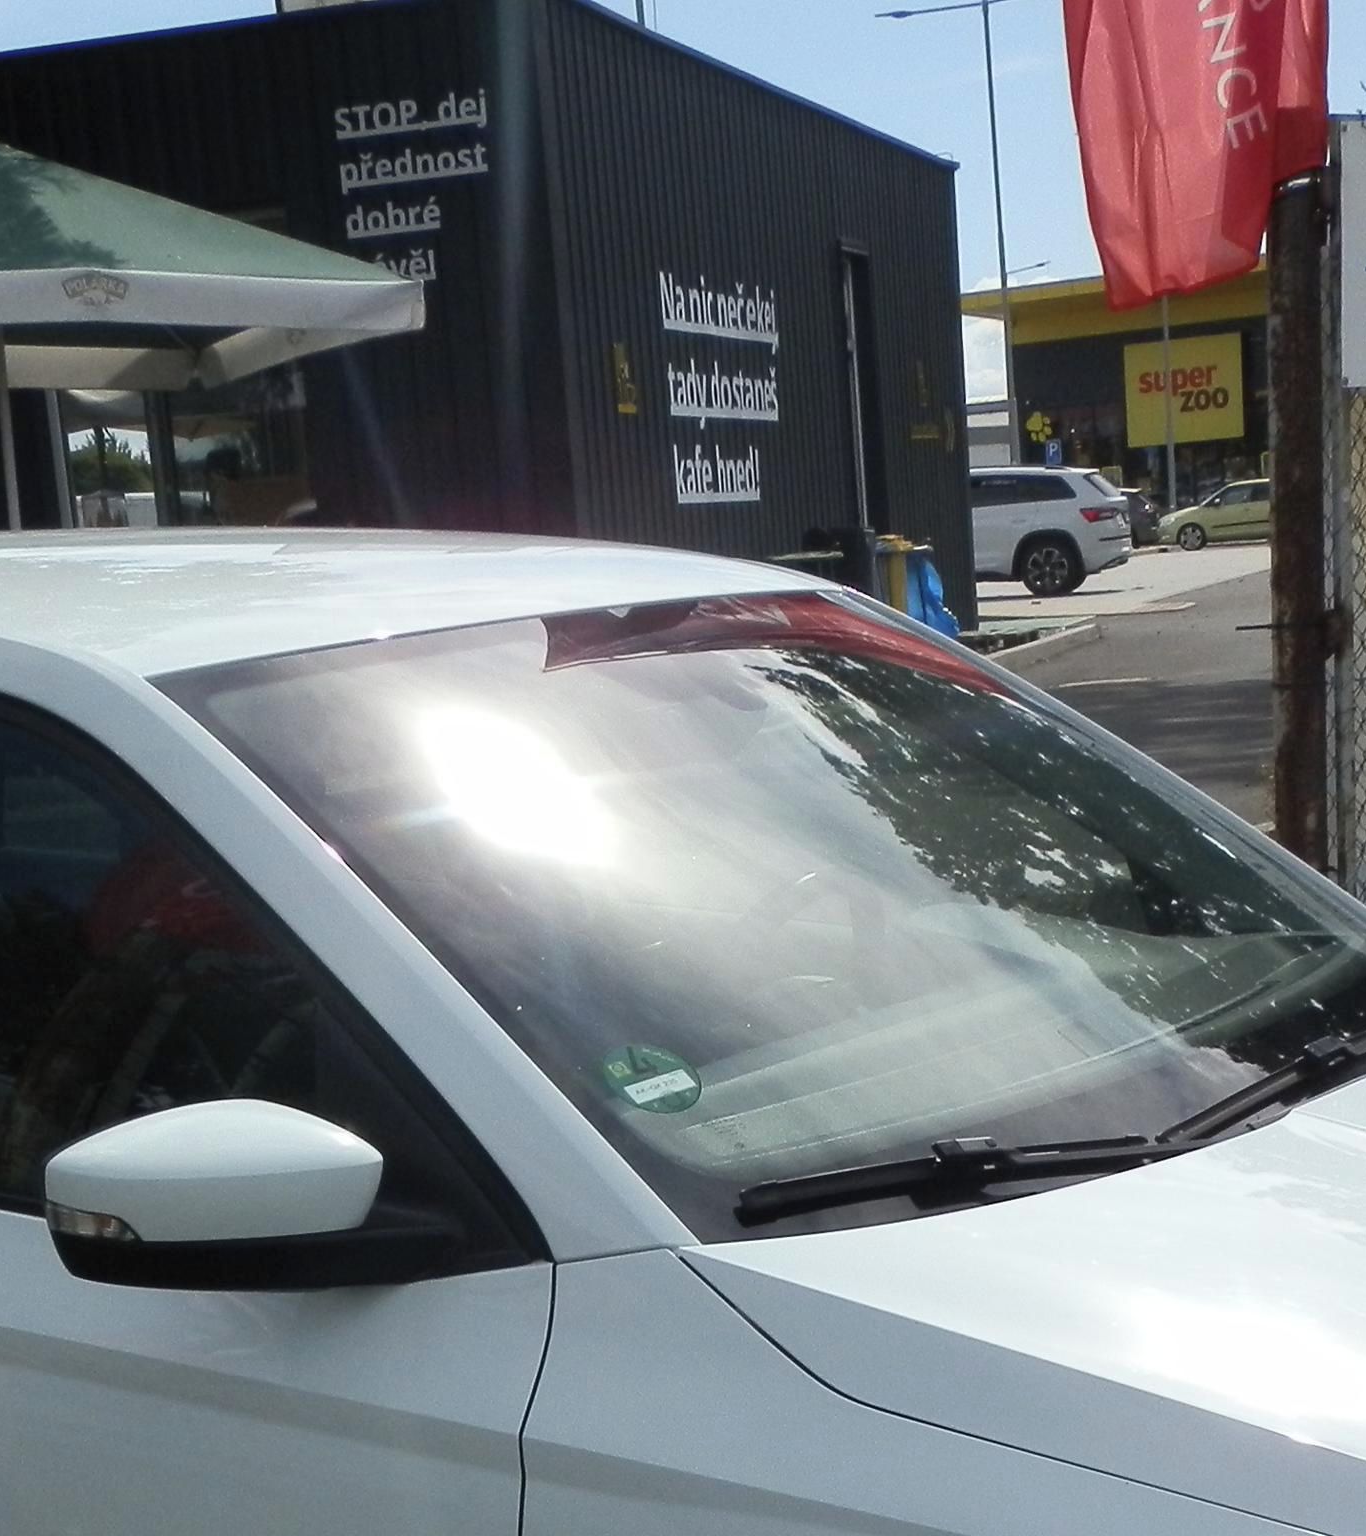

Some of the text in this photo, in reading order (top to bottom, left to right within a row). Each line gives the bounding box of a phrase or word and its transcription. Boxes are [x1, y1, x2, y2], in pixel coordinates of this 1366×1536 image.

[438, 88, 488, 128] dej
[339, 144, 489, 195] přednost
[346, 196, 441, 239] dobré
[659, 270, 685, 328] Na
[689, 274, 714, 330] nic
[668, 358, 707, 429] tady
[712, 360, 780, 420] dostaneš
[1138, 364, 1218, 397] super
[1180, 386, 1230, 413] zoo
[674, 443, 760, 500] kafe hned!
